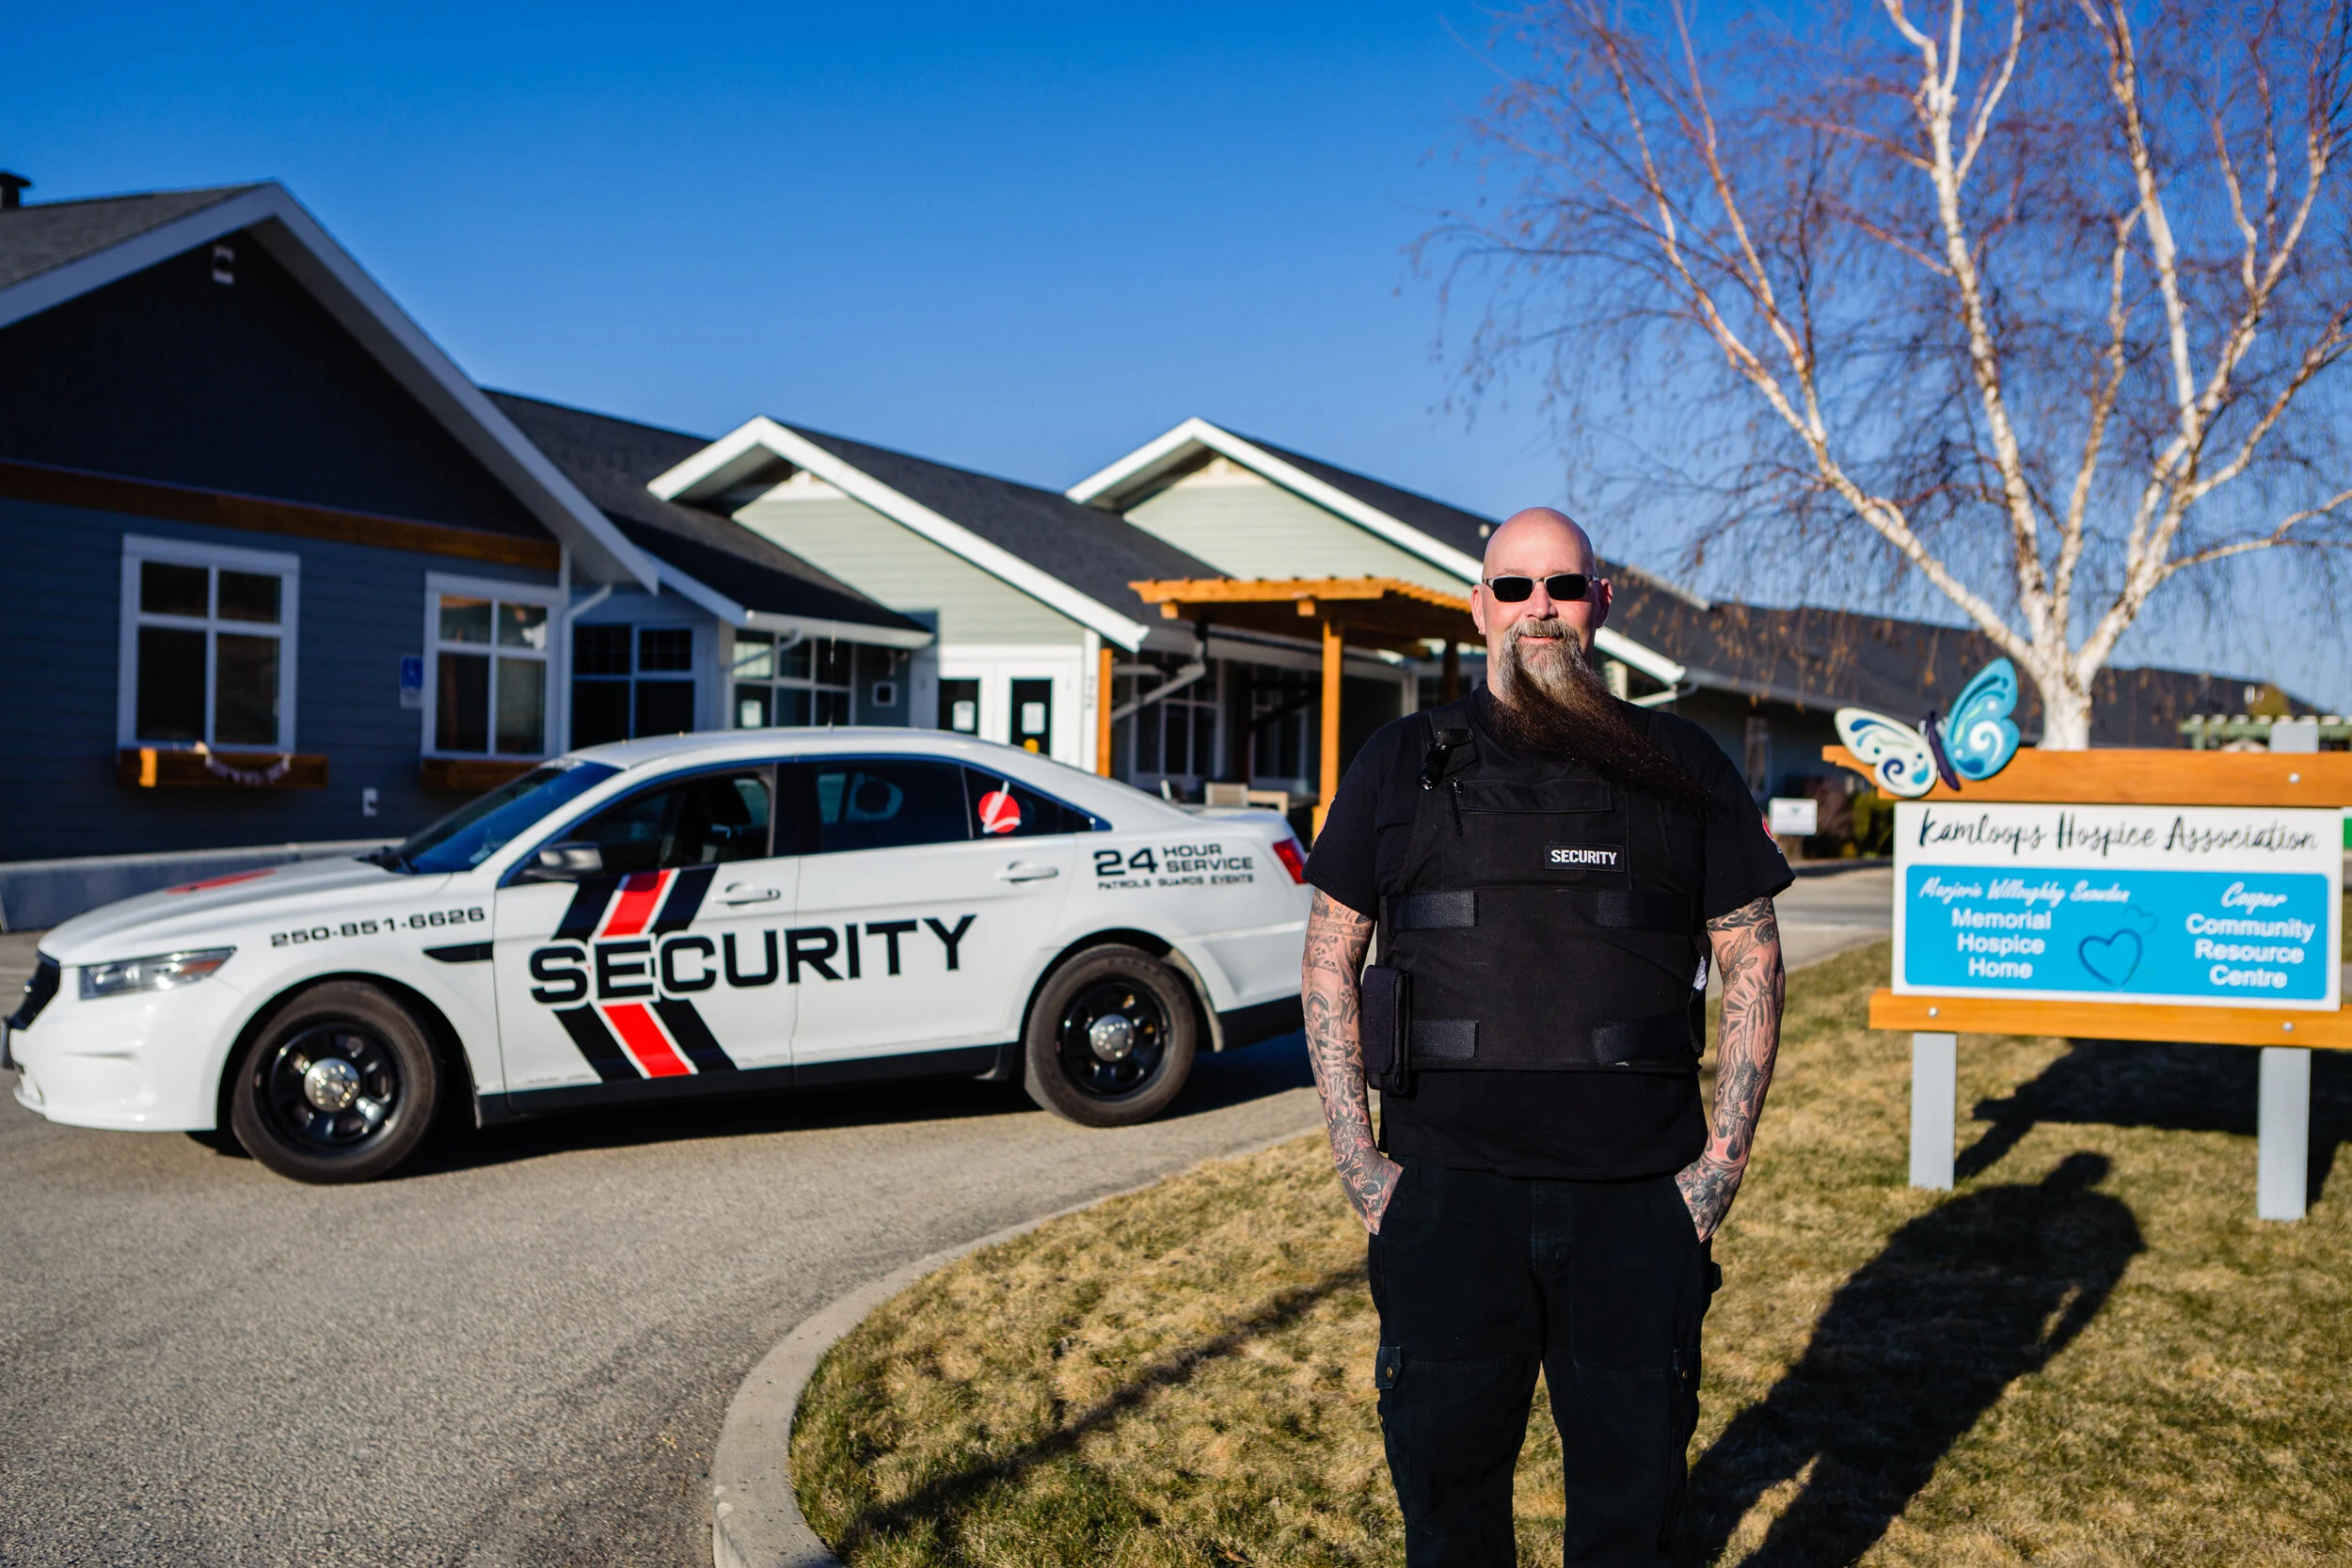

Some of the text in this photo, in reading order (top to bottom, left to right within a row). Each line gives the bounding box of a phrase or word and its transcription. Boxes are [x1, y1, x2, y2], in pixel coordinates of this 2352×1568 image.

[1918, 807, 2318, 857] Kamloops Hospice Association
[1093, 847, 1158, 877] 24
[1163, 843, 1222, 858] HOUR
[1550, 849, 1617, 865] SECURITY
[1167, 857, 1253, 873] SERVICE
[1098, 873, 1254, 890] PATROLS GUARDS EVENTS
[1918, 876, 1983, 905] Marjorie
[1987, 878, 2066, 908] Willoughby
[2221, 881, 2288, 915] Cooper
[1951, 907, 2052, 930] Memorial
[2185, 912, 2316, 944] Community
[1957, 931, 2046, 958] Hospice
[2195, 938, 2305, 964] Resource
[529, 913, 977, 1004] SECURITY
[1968, 956, 2034, 979] Home
[2209, 963, 2289, 990] Centre
